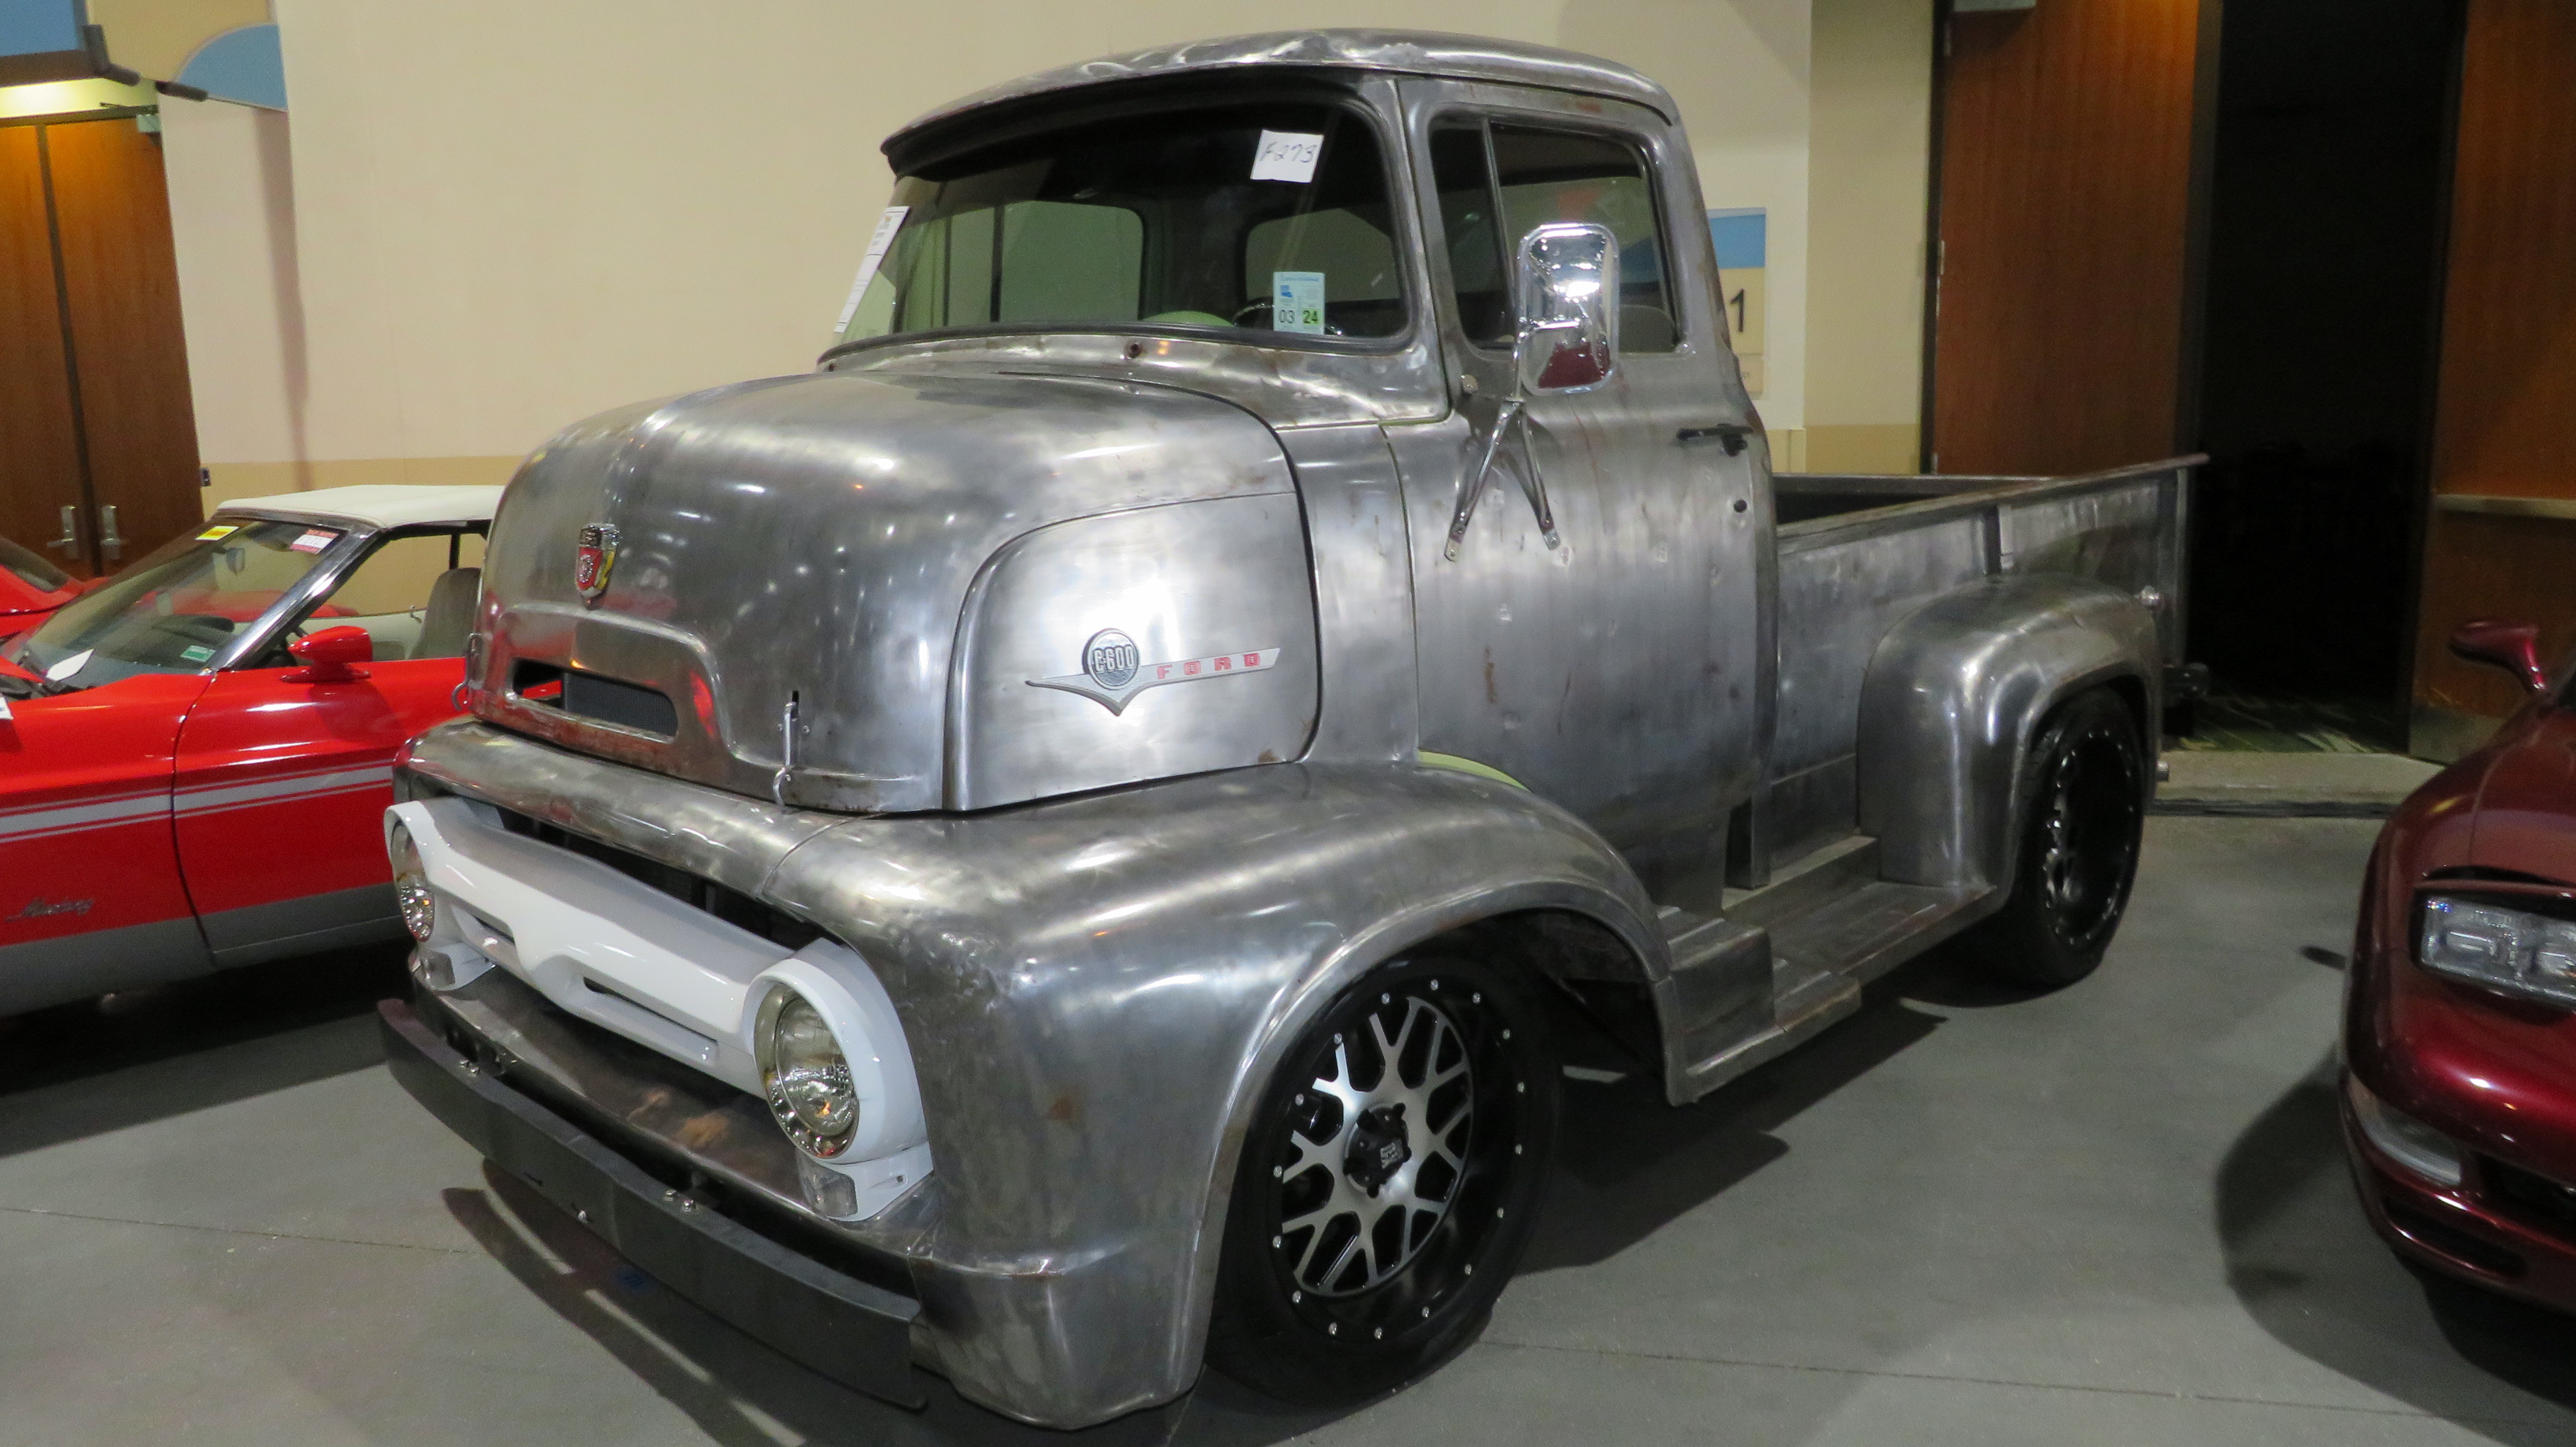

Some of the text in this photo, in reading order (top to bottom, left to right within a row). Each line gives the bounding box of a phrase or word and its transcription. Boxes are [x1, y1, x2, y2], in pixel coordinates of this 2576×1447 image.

[1279, 309, 1318, 324] 03 24
[1730, 288, 1745, 332] 1
[1156, 652, 1261, 679] FORD
